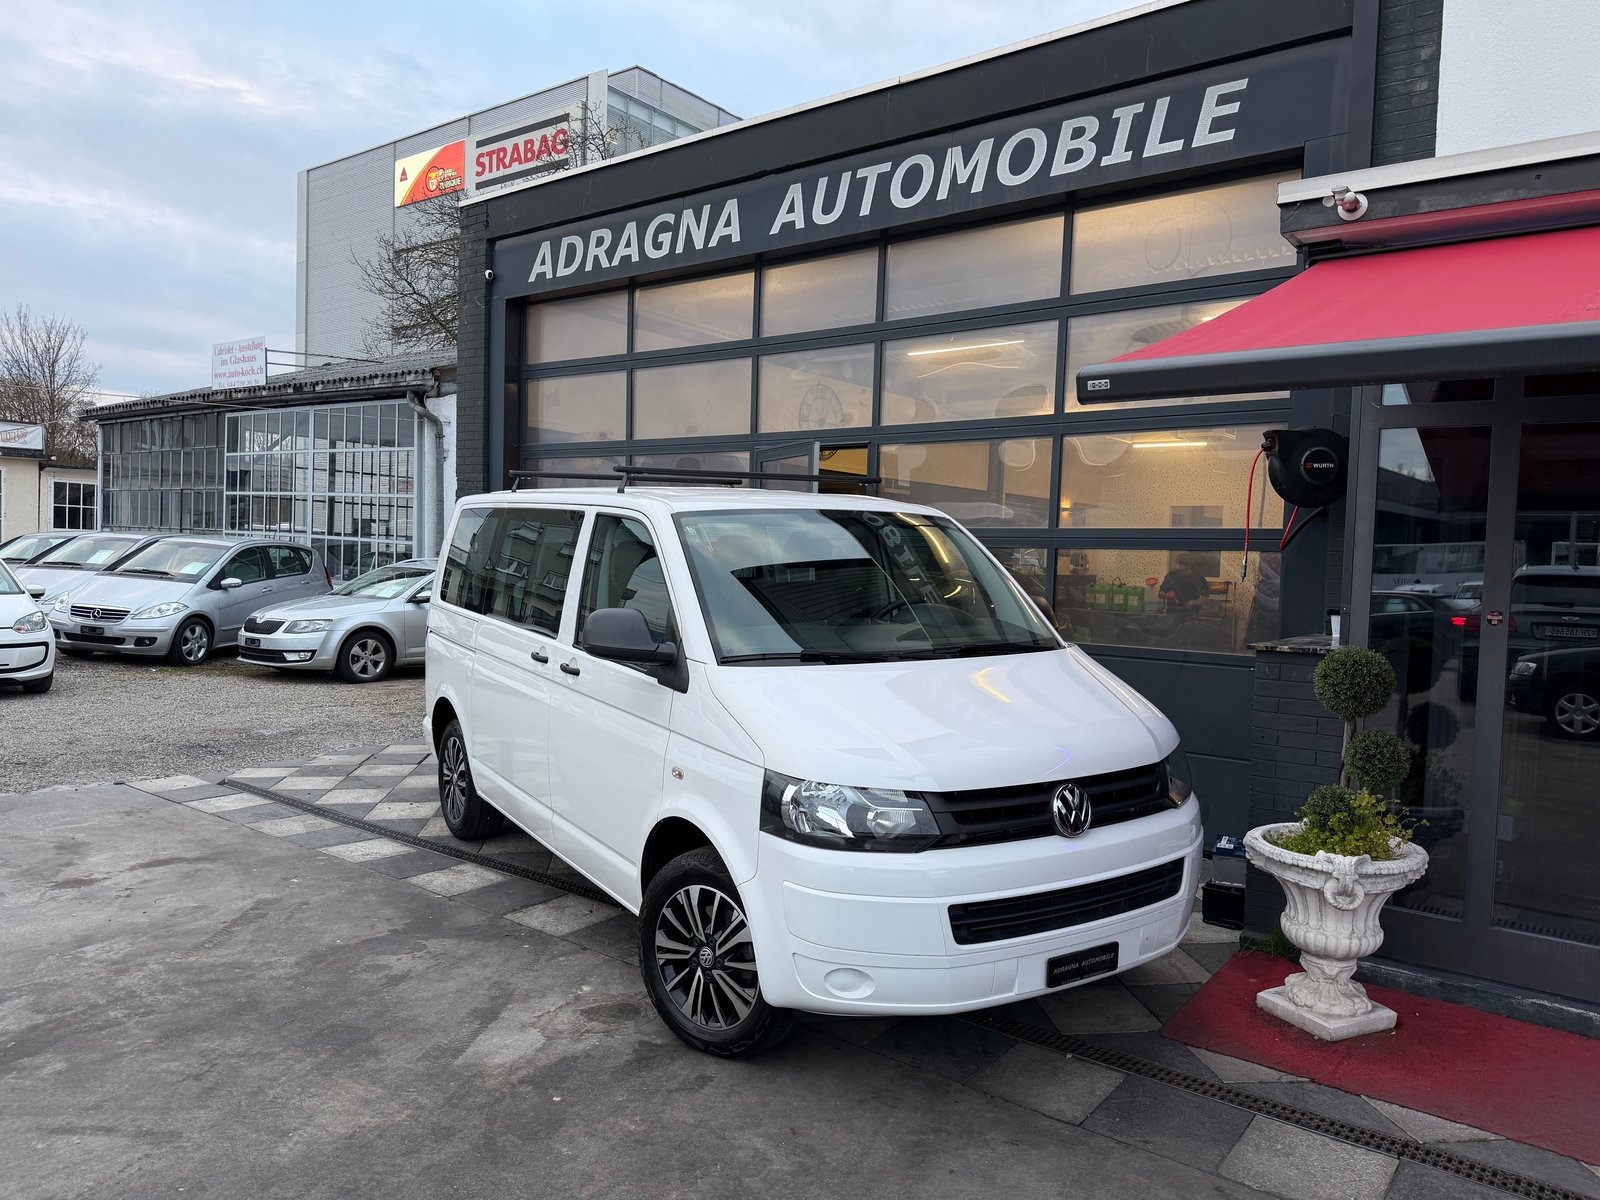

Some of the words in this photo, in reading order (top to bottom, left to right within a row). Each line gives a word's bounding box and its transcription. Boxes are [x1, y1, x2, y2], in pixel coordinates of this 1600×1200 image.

[475, 128, 569, 177] STRABAG
[528, 198, 742, 283] ADRAGNA
[768, 77, 1249, 235] AUTOMOBILE
[220, 357, 228, 366] im
[229, 354, 257, 364] Glashaus
[214, 365, 264, 379] www.auto-koch.ch
[1053, 962, 1079, 974] ADRAGNA
[1081, 952, 1115, 967] AUTOMOBILE
